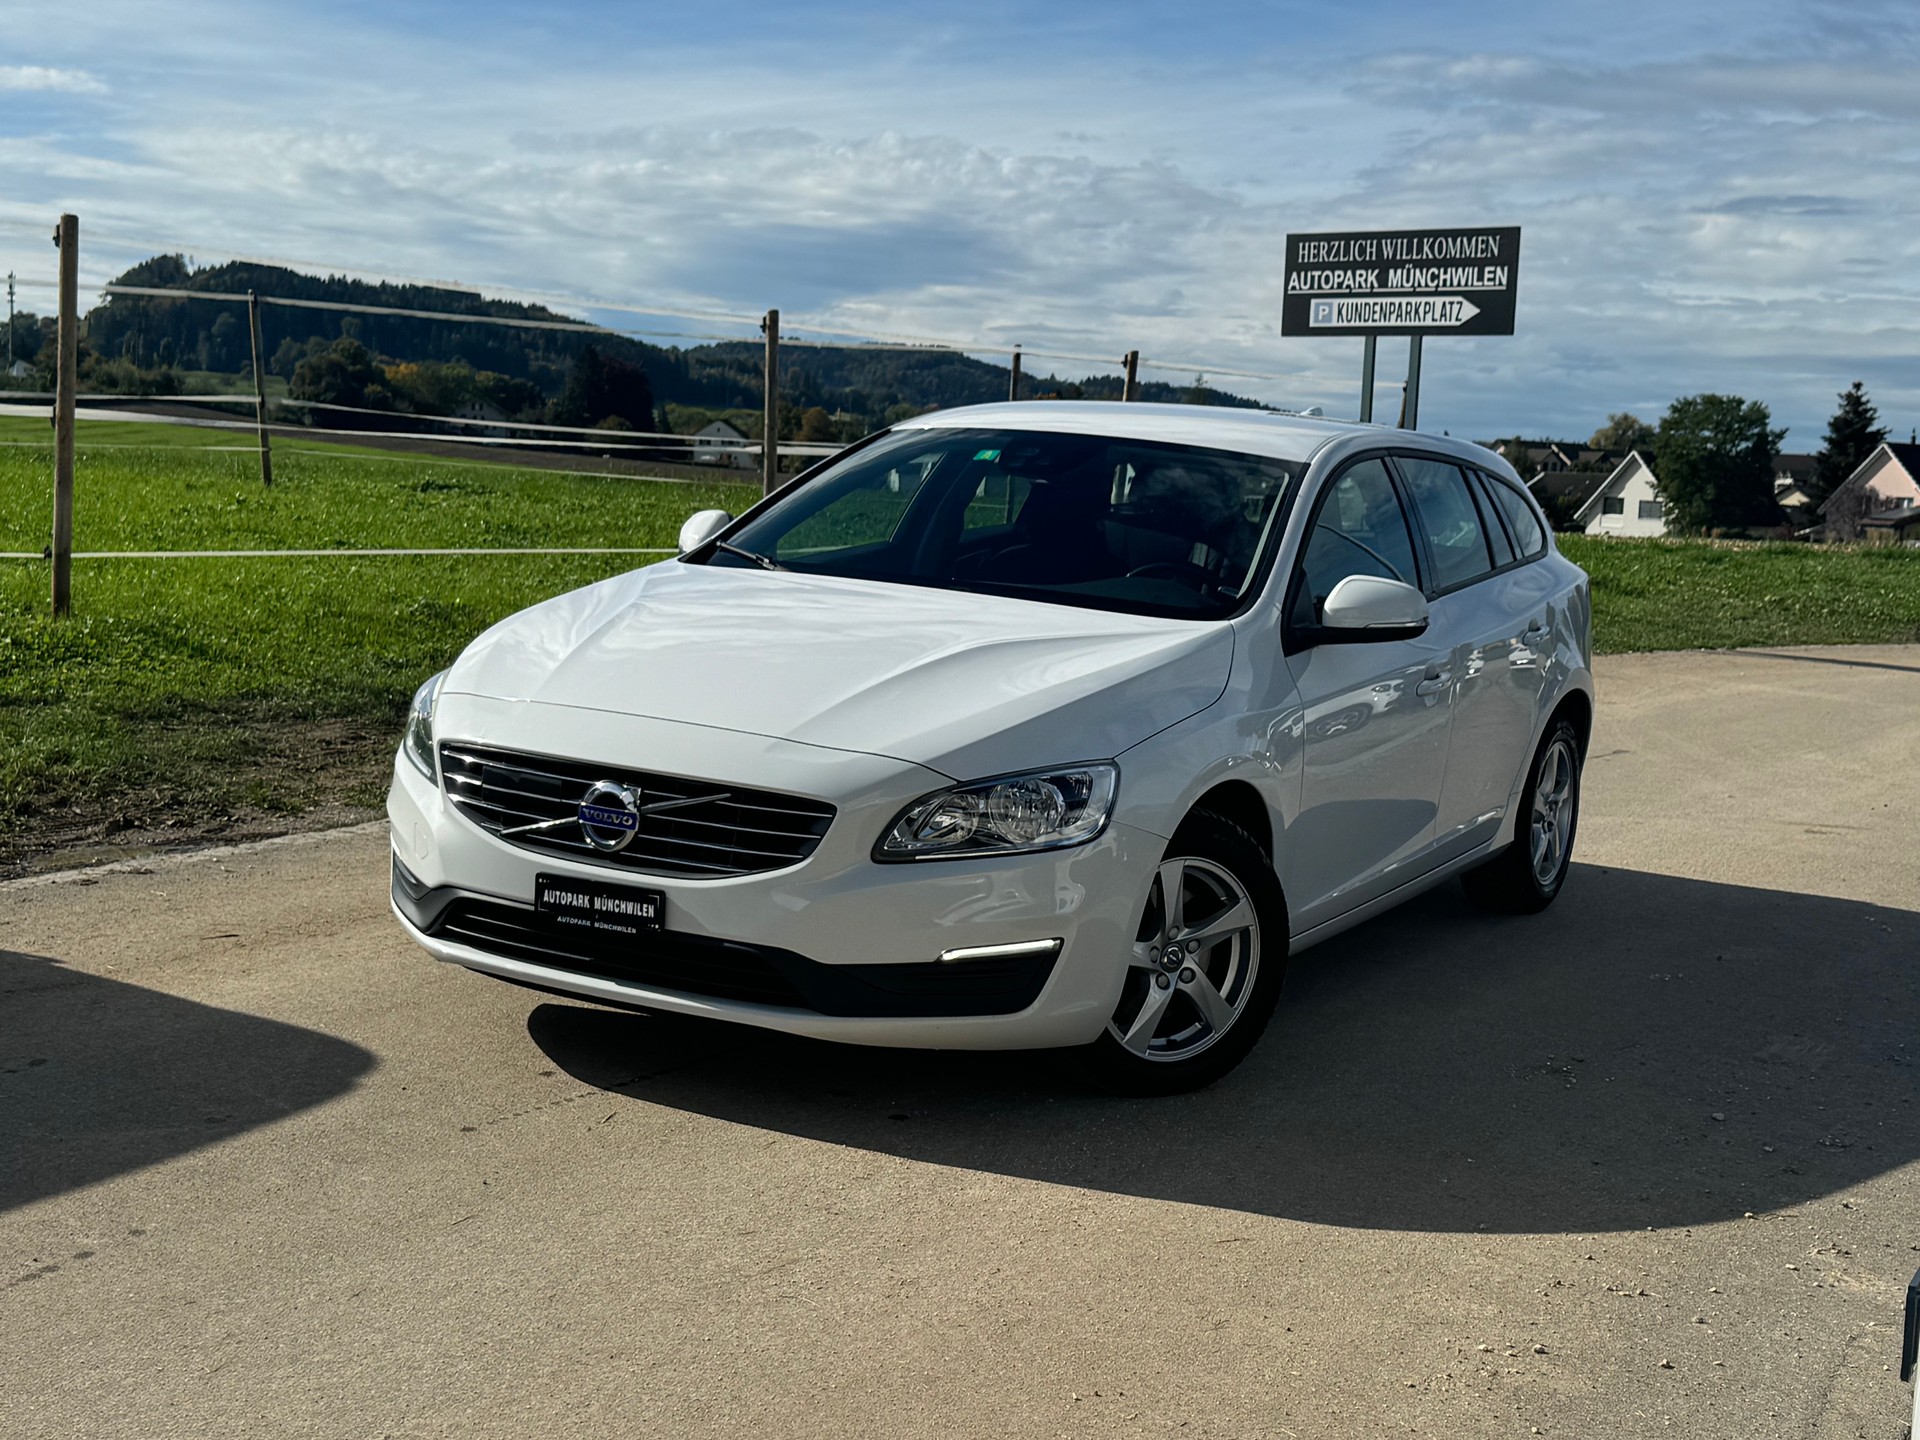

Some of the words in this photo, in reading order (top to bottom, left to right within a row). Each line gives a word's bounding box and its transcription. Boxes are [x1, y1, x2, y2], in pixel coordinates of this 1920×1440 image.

[1298, 239, 1378, 263] HERZLICH
[1381, 235, 1501, 260] WILLKOMMEN
[1287, 268, 1380, 290] AUTOPARK
[1388, 264, 1508, 288] MÜNCHWILEN
[1318, 305, 1330, 321] P
[1336, 301, 1463, 323] KUNDENPARKPLATZ
[582, 807, 634, 826] VOLVO
[543, 889, 590, 909] AUTOPARK
[594, 894, 655, 918] MÜNCHWILEN
[557, 915, 591, 927] AUTOPARK
